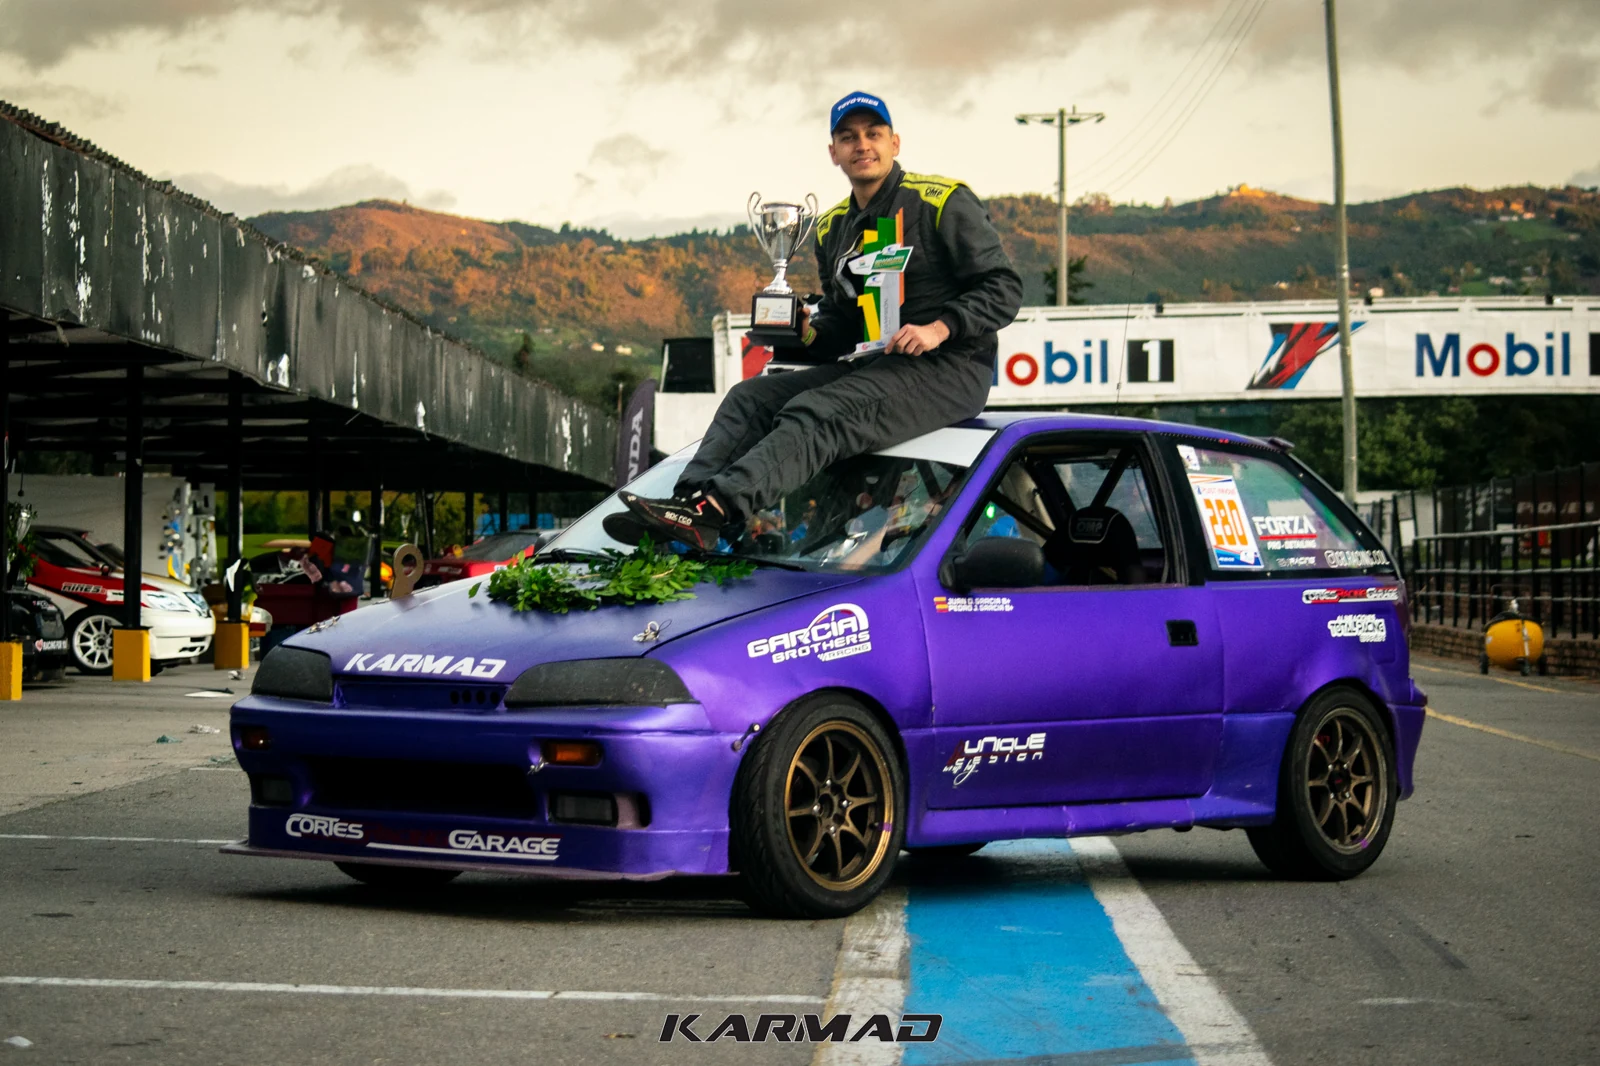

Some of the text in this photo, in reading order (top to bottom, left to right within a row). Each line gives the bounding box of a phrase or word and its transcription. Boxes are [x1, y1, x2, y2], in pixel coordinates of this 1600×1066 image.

[857, 292, 881, 342] 1
[1142, 340, 1160, 382] 1
[1415, 332, 1571, 377] Mobil
[1075, 520, 1104, 533] OMP
[1203, 498, 1249, 547] 280
[1252, 516, 1317, 535] FORZA
[772, 630, 871, 663] BROTHERS
[827, 642, 870, 658] RACING
[343, 653, 507, 679] KARMAD
[285, 813, 364, 839] CORTES
[448, 829, 561, 854] GARAGE
